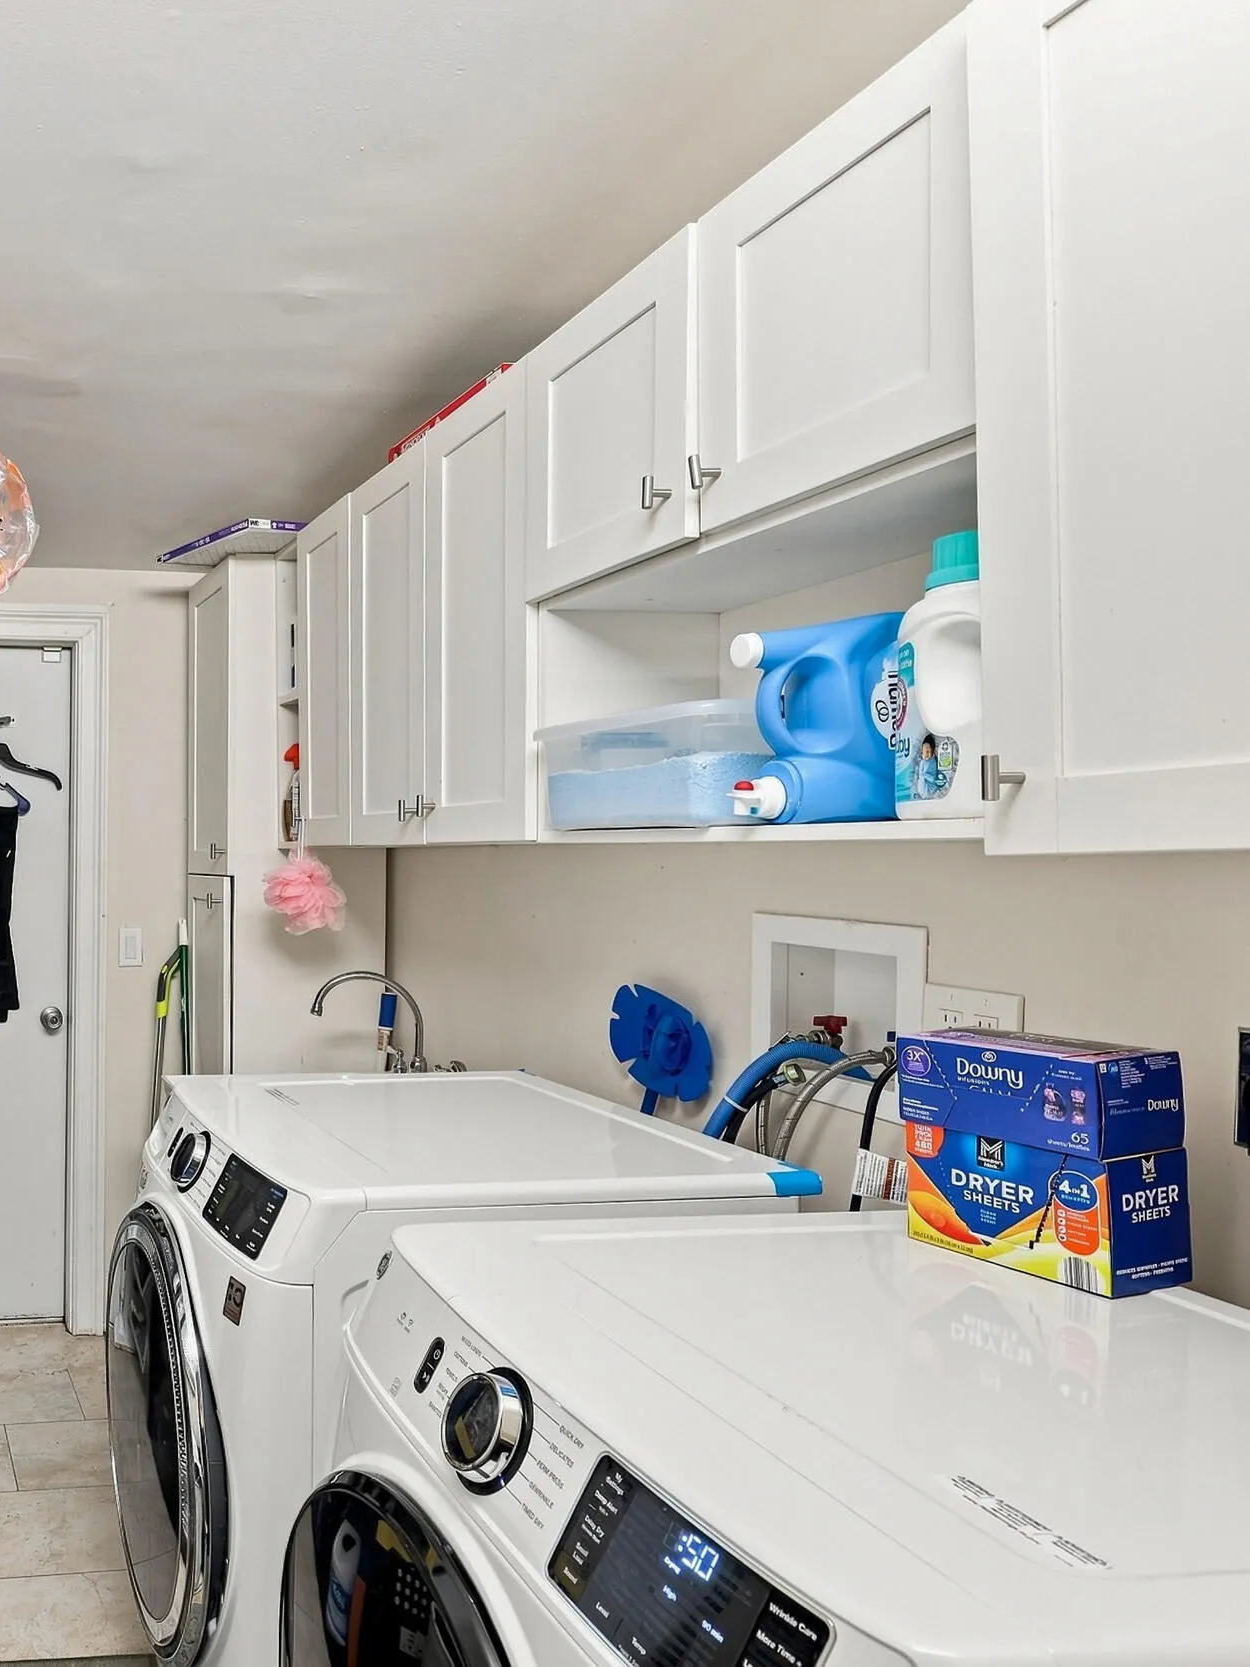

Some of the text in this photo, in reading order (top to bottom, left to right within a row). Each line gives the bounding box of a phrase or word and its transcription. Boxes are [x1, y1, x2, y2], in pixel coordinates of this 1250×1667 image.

[956, 1057, 1024, 1090] Downy
[1147, 1098, 1179, 1112] Downy
[1071, 1131, 1090, 1145] 65
[951, 1168, 1034, 1206] DRYER
[1122, 1184, 1179, 1212] DRYER
[963, 1190, 1020, 1214] SHEETS
[1131, 1205, 1171, 1223] SHEETS
[549, 1442, 575, 1469] DELICATES
[662, 1584, 678, 1602] High
[701, 1619, 724, 1644] 90 min
[769, 1601, 818, 1643] Wrinkle Care
[631, 1636, 647, 1656] Temp
[755, 1628, 776, 1650] More
[775, 1643, 797, 1664] Time
